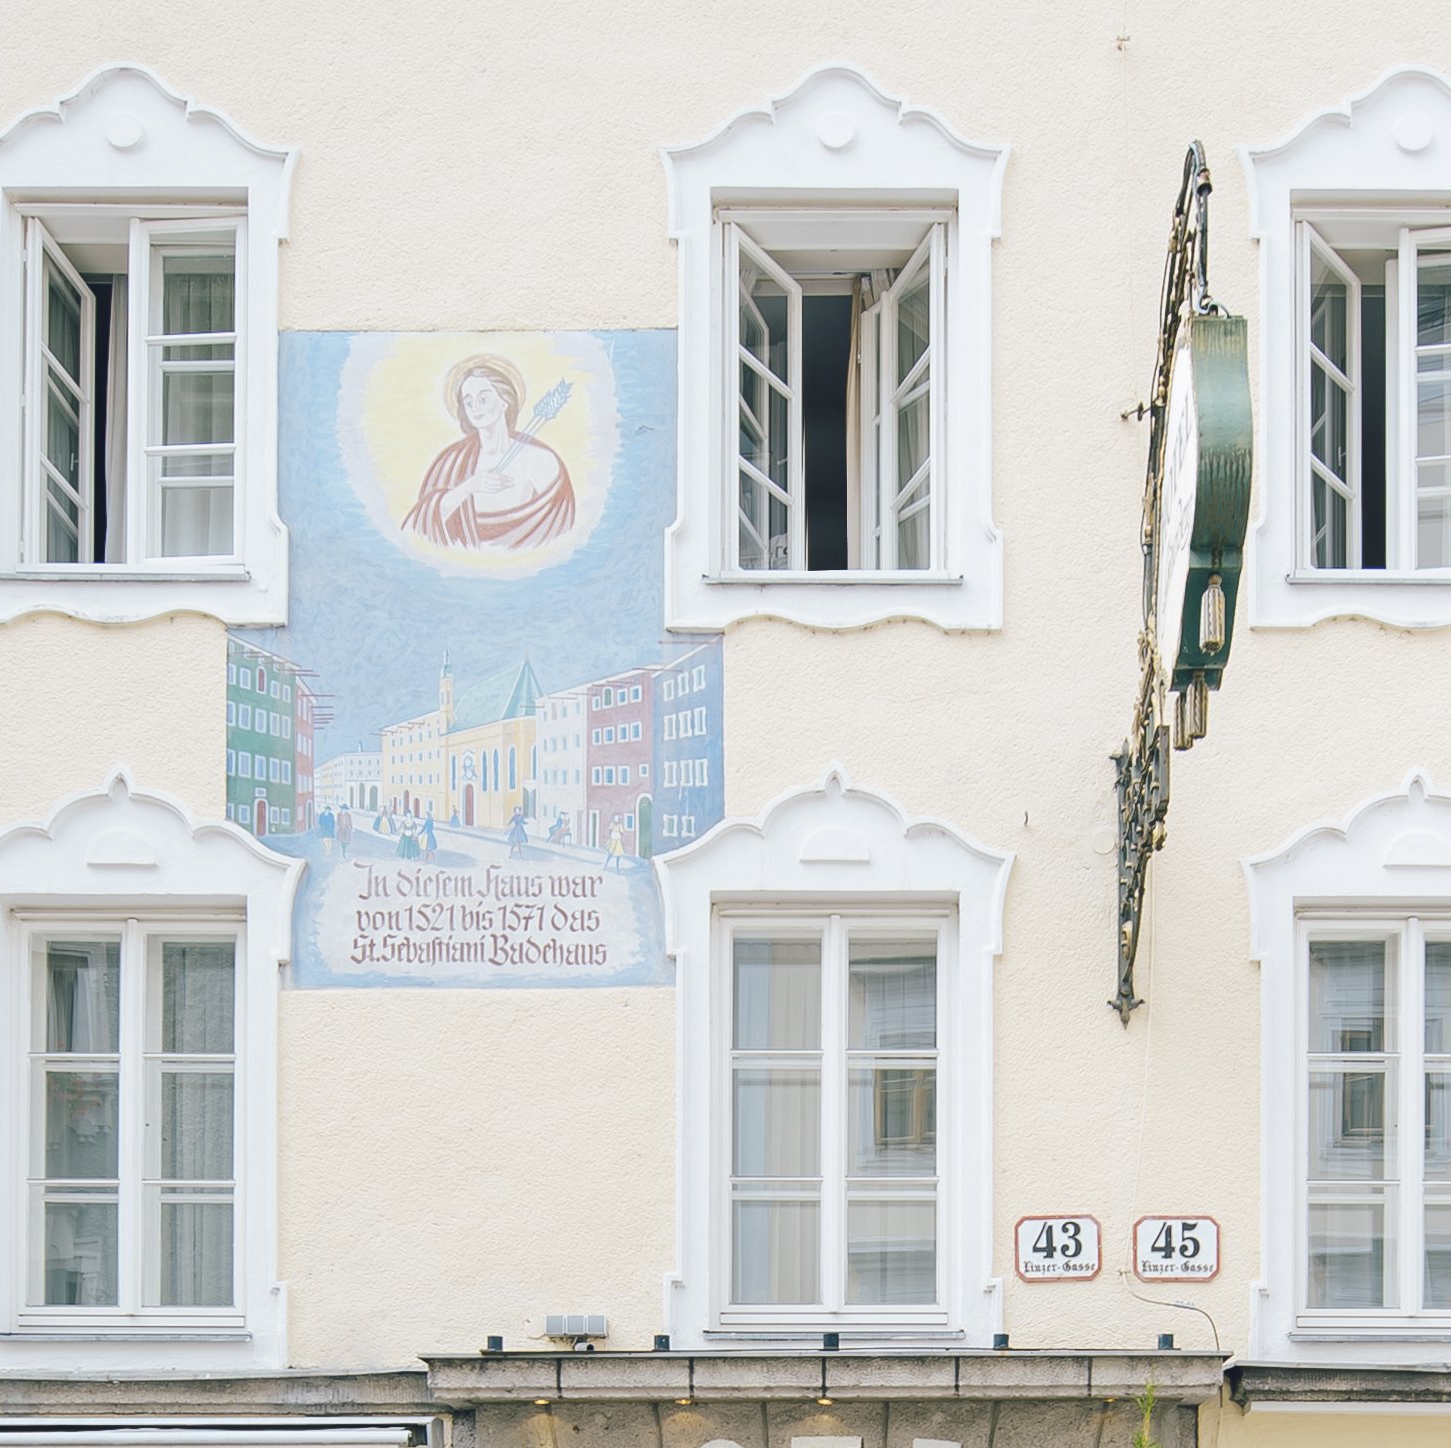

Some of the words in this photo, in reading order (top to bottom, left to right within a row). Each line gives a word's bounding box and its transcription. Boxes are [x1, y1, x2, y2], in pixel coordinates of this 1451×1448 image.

[353, 861, 390, 900] In
[477, 864, 543, 901] Haus
[548, 875, 603, 898] war
[356, 910, 403, 932] von
[403, 902, 456, 932] 1521
[460, 900, 493, 932] bis
[497, 902, 546, 932] 1571
[550, 901, 600, 932] das
[488, 933, 607, 967] Badehaus
[1032, 1221, 1082, 1259] 43
[1150, 1221, 1200, 1259] 45
